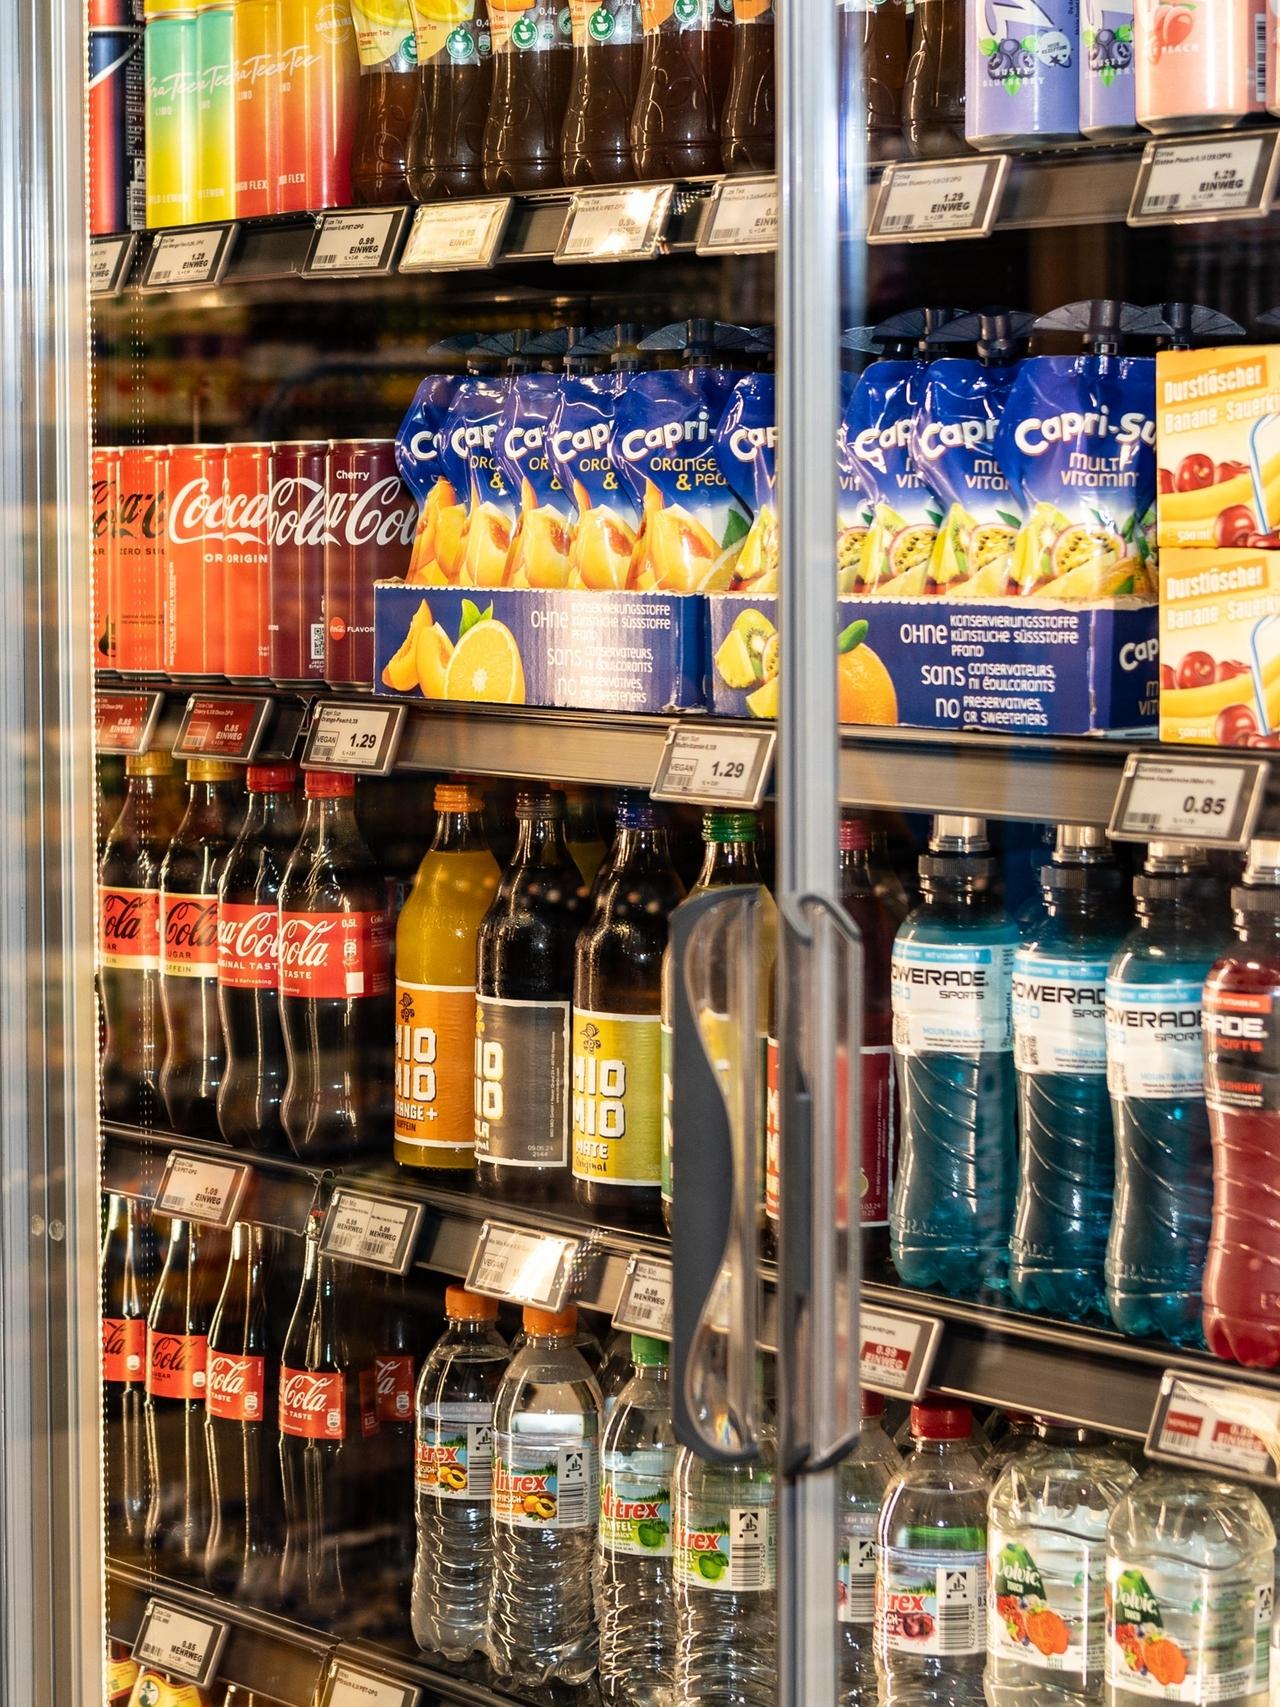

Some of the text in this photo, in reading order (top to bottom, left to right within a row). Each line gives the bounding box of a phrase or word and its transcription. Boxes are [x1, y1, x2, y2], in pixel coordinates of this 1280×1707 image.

[289, 174, 306, 185] FLEX
[1213, 168, 1236, 181] 1.29
[1198, 179, 1245, 192] EINWEG
[943, 192, 964, 203] 1.29
[930, 201, 970, 213] EINWEG
[358, 236, 375, 246] 0.99
[350, 245, 379, 254] EINWEG
[192, 252, 205, 261] 1.29
[182, 259, 208, 269] EINWEG
[1165, 407, 1217, 435] Banane
[336, 469, 370, 481] Cherry
[602, 472, 618, 490] &
[676, 472, 692, 491] &
[226, 554, 268, 564] ORIGIN
[1167, 605, 1219, 632] Banane
[110, 724, 135, 734] EINWEG
[224, 723, 240, 732] 0.85
[216, 731, 243, 741] EINWEG
[317, 735, 336, 744] VEGAN
[350, 733, 377, 748] 1.29
[671, 762, 694, 772] VEGAN
[712, 761, 745, 778] 1.29
[1183, 796, 1227, 815] 0.85
[283, 970, 312, 980] TASTE
[939, 990, 985, 1000] SPORTS
[576, 1141, 609, 1160] MATE
[195, 1193, 222, 1206] EINWEG
[336, 1223, 364, 1234] MEHRWEG
[369, 1230, 397, 1243] MEHRWEG
[644, 1287, 659, 1296] 0.99
[633, 1292, 666, 1306] MEHRWEG
[875, 1344, 898, 1358] 0.99
[864, 1352, 904, 1370] EINWEG
[284, 1374, 334, 1412] Cola
[289, 1411, 313, 1421] TASTE
[181, 1639, 196, 1651] 0.85
[170, 1643, 203, 1664] MEHRWEG
